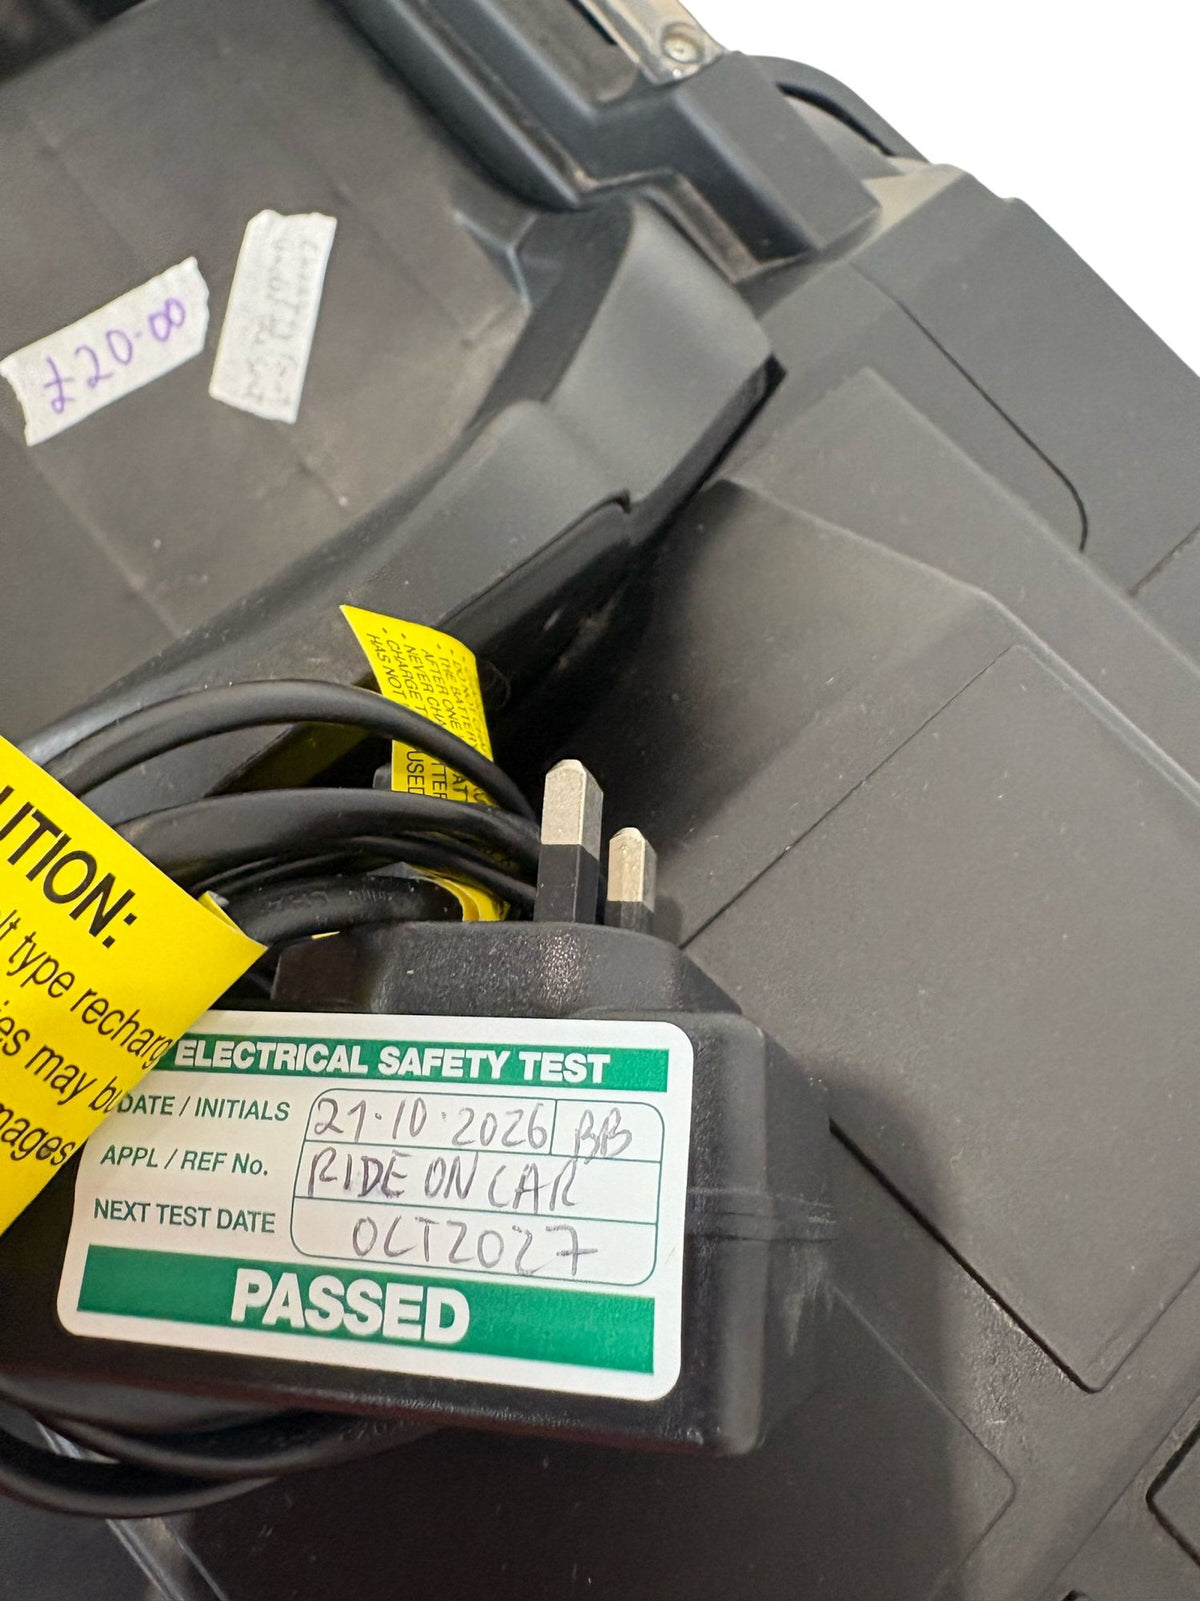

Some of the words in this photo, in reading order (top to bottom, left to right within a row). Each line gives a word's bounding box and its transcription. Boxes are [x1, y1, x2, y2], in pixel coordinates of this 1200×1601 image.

[43, 298, 186, 414] £20.00
[366, 632, 392, 665] HAS
[383, 665, 408, 700] NOT
[386, 639, 423, 702] CHARGE
[404, 643, 434, 694] NEVER
[421, 648, 450, 696] AFTER
[442, 698, 462, 730] ONE
[6, 931, 76, 998] type
[24, 1044, 97, 1106] may
[173, 1039, 369, 1075] ELECTRICAL
[377, 1045, 510, 1080] SAFETY
[518, 1051, 612, 1084] TEST
[117, 1094, 175, 1116] DATE
[194, 1098, 290, 1122] INITIALS
[100, 1144, 158, 1170] APPL
[181, 1149, 225, 1173] REF
[232, 1152, 269, 1176] No.
[307, 1146, 412, 1200] RIDE
[423, 1151, 479, 1200] ON
[488, 1156, 578, 1215] CAR
[94, 1197, 150, 1223] NEXT
[156, 1202, 212, 1228] TEST
[216, 1209, 276, 1234] DATE
[230, 1267, 470, 1345] PASSED
